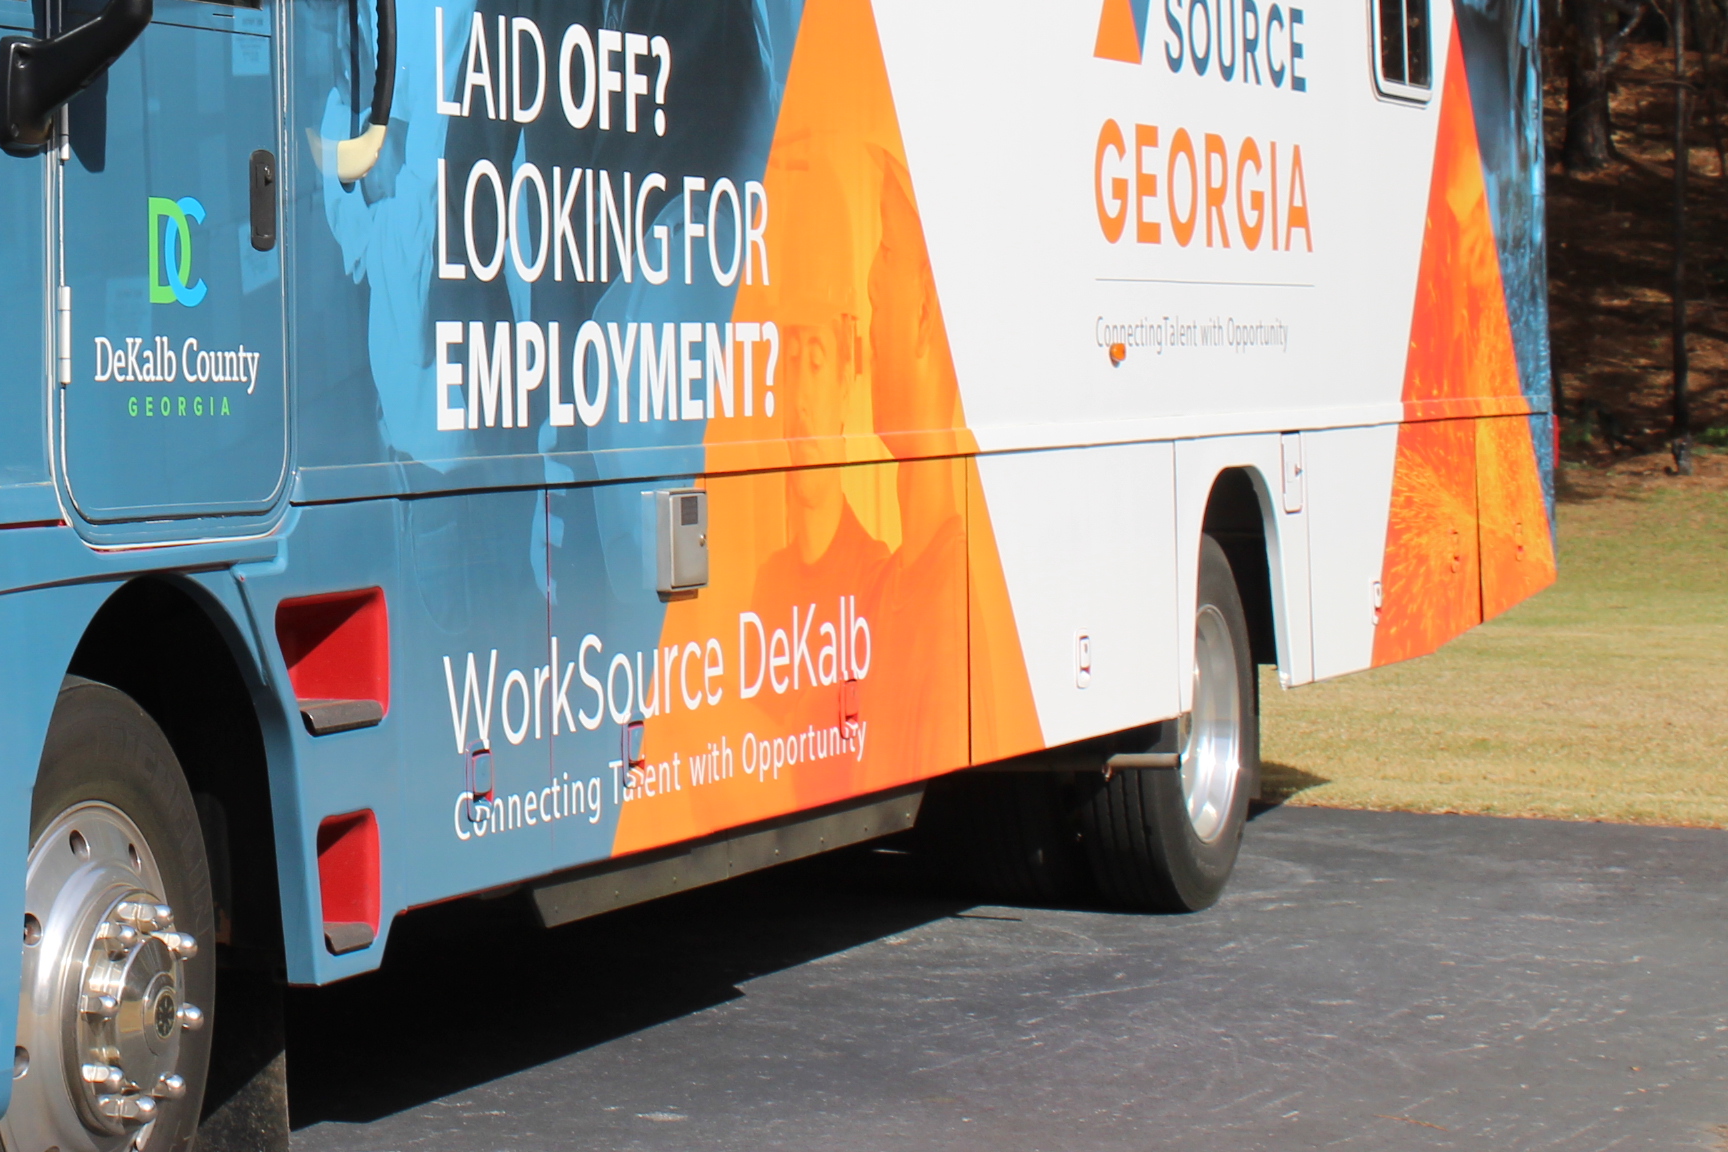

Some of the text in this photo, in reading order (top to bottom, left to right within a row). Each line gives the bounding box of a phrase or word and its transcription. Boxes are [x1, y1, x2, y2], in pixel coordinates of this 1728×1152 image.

[435, 6, 672, 137] LAID OFF?
[437, 158, 771, 286] LOOKING FOR
[1094, 118, 1314, 253] GEORGIA
[93, 336, 260, 395] DeKalb County
[435, 320, 780, 431] EMPLOYMENT?
[1200, 315, 1223, 347] with
[1226, 316, 1289, 354] Opportunity
[128, 396, 231, 417] GEORGIA
[442, 595, 872, 755] WorkSource DeKalb
[689, 735, 734, 787] with
